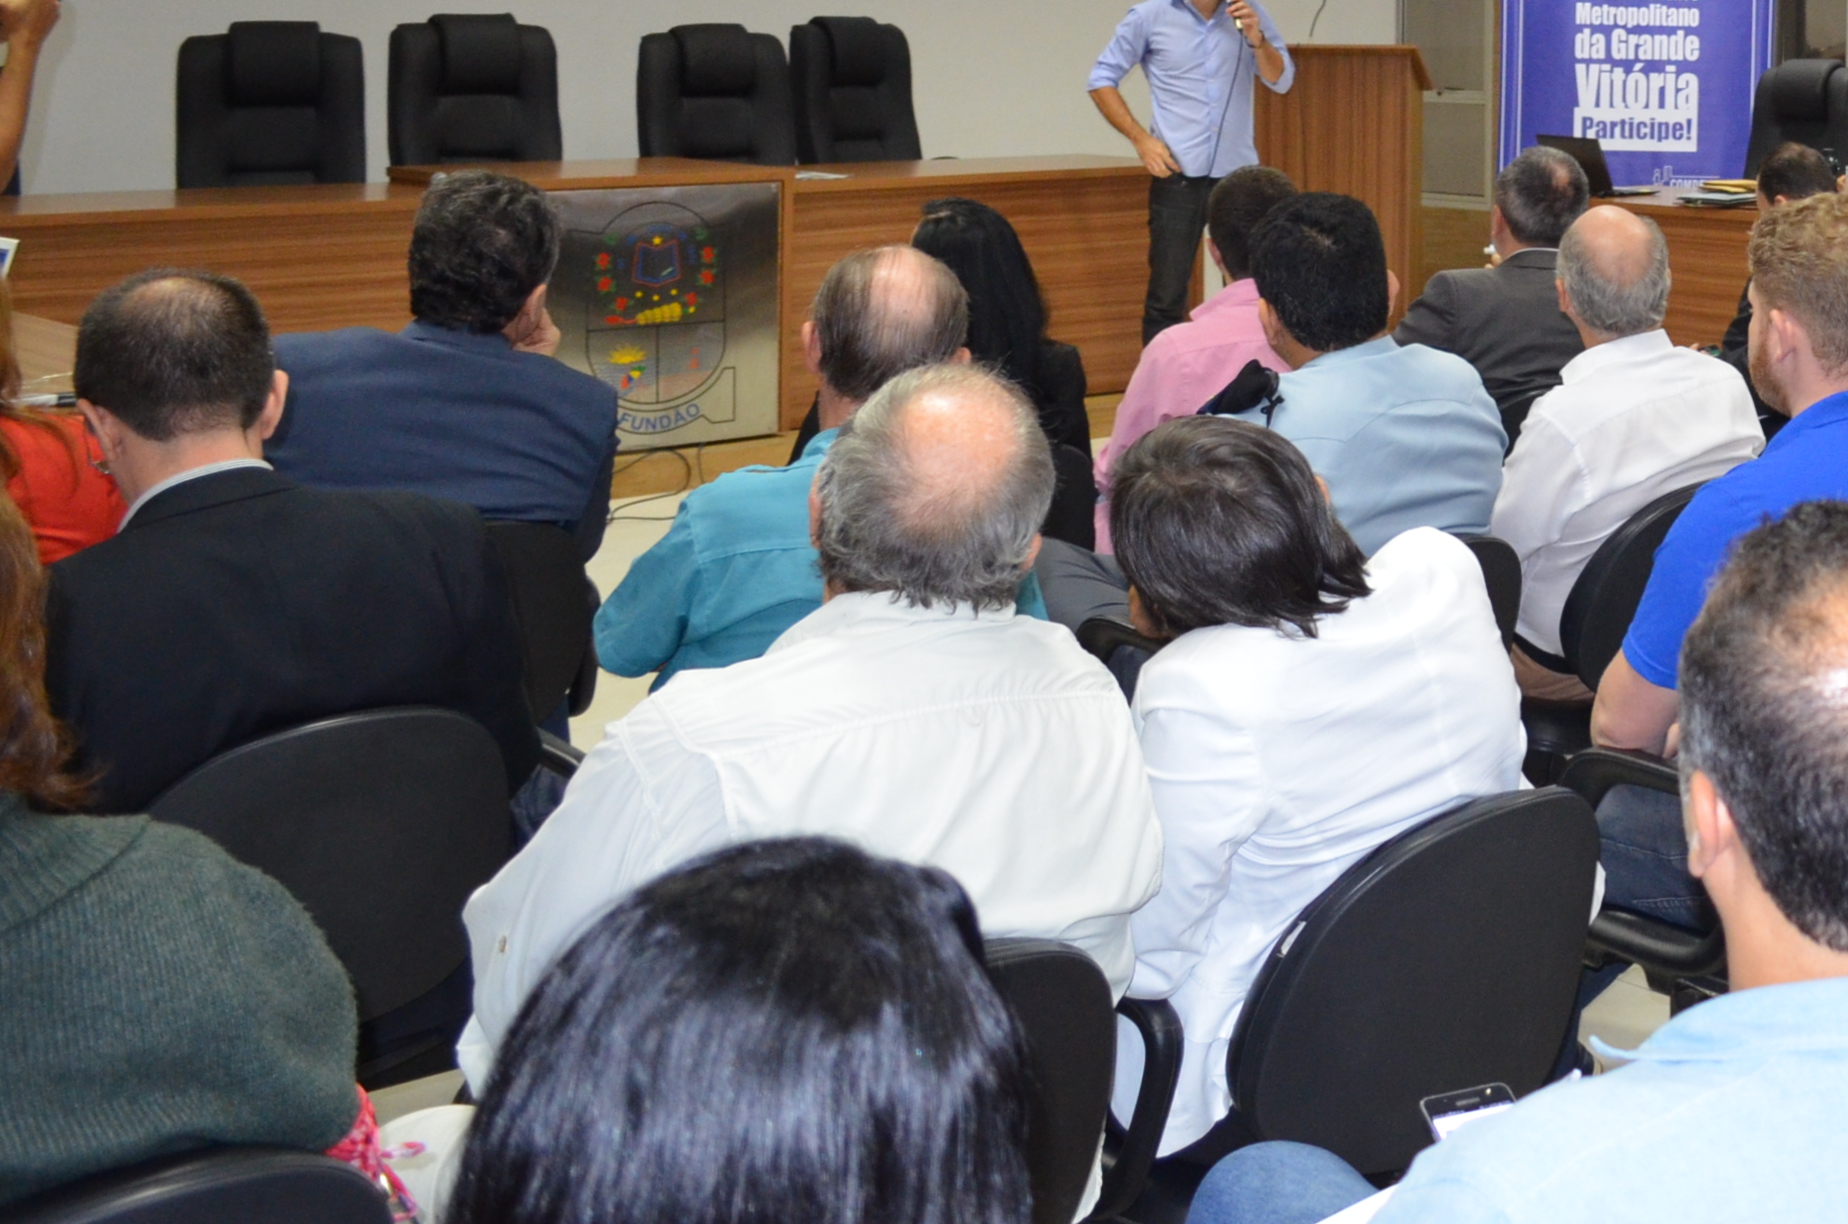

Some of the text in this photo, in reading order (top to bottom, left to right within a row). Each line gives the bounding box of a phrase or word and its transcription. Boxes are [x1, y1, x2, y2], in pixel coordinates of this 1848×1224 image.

[1575, 2, 1700, 27] Metropolitano
[1574, 28, 1701, 61] da Grande
[1574, 62, 1700, 111] Vitória
[1581, 115, 1693, 143] Participe!
